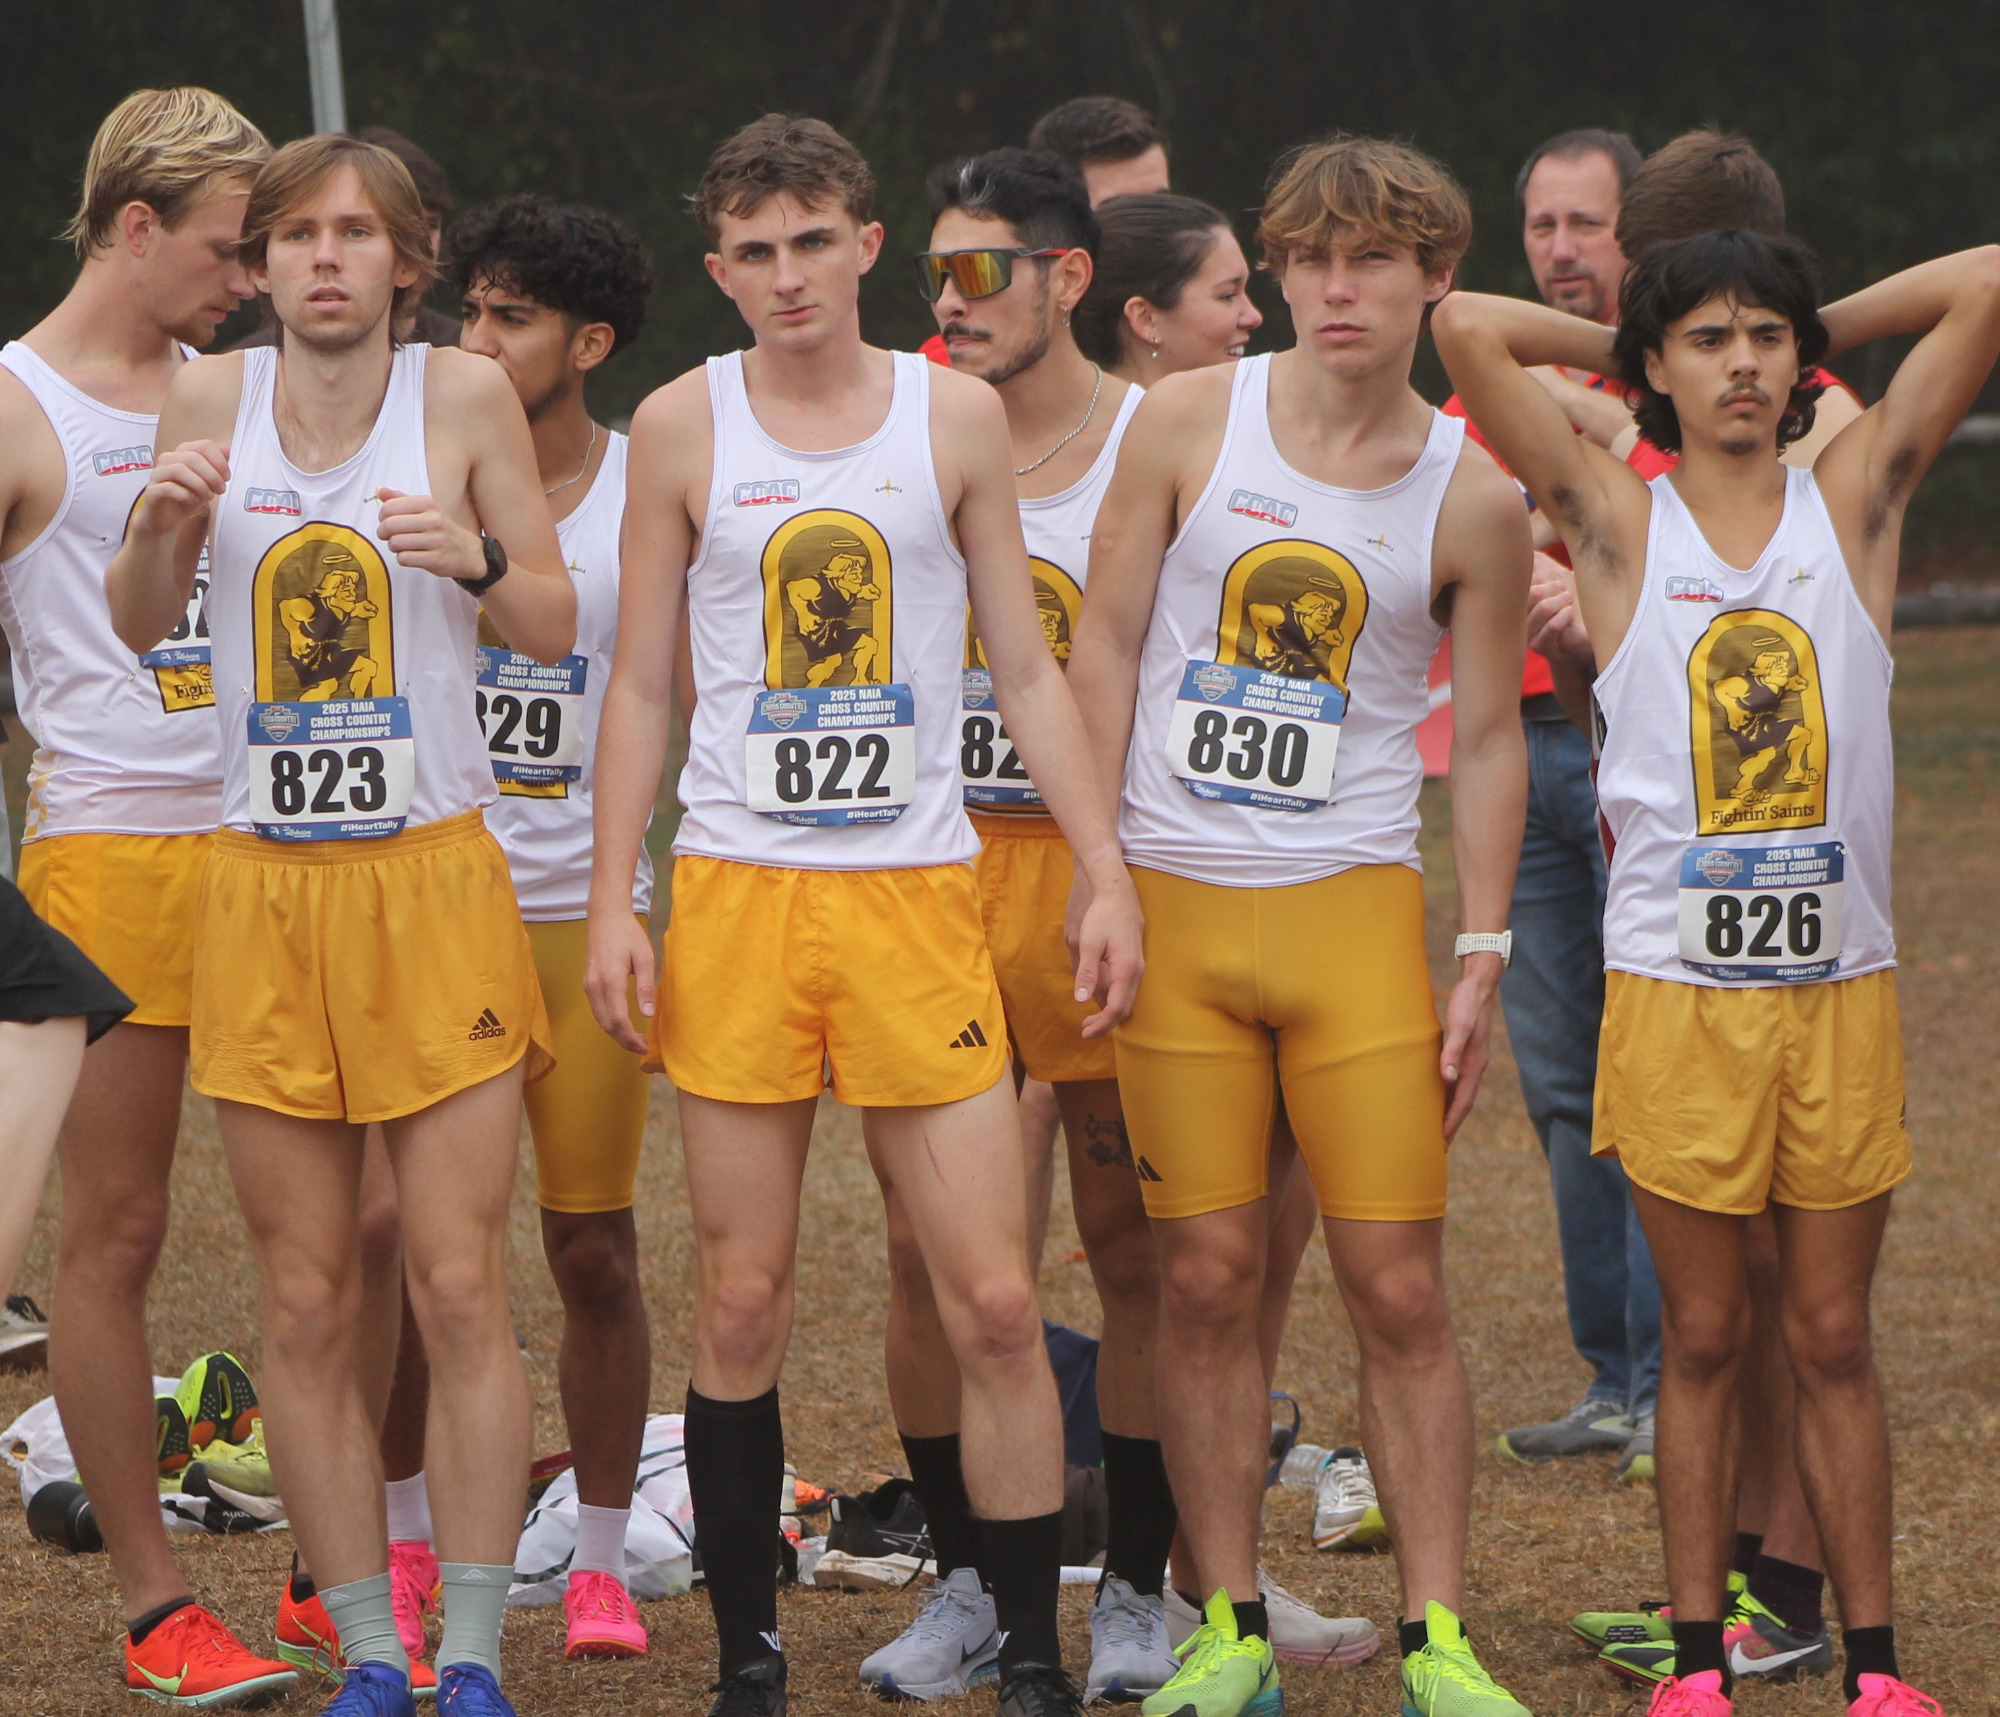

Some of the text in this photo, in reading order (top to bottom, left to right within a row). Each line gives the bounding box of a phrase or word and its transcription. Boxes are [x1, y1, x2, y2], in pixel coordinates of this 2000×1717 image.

[498, 664, 572, 680] CROSS COUNTRY
[174, 679, 214, 701] Fighti
[497, 676, 570, 692] CHAMPIONSHIPS
[1259, 673, 1311, 692] 2025 NAIA
[830, 688, 882, 702] 2025 NAIA
[1245, 684, 1277, 699] CROSS
[1280, 690, 1325, 706] COUNTRY
[322, 701, 375, 715] 2025 NAIA
[818, 700, 896, 715] CROSS COUNTRY
[1242, 696, 1321, 719] CHAMPIONSHIPS
[310, 713, 391, 729] CROSS COUNTRY
[817, 713, 896, 728] CHAMPIONSHIPS
[310, 726, 391, 741] CHAMPIONSHIPS
[961, 715, 1030, 780] 82
[1187, 709, 1309, 788] 830
[511, 766, 565, 777] #iHeartTally
[775, 733, 890, 803] 822
[271, 746, 387, 816] 823
[1250, 792, 1307, 809] #iHeartTally
[846, 808, 900, 819] #iHeartTally
[1710, 804, 1815, 827] Fightin' Saints
[340, 821, 399, 833] #iHeartTally
[1765, 847, 1816, 862] 2025 NAIA
[1753, 858, 1829, 875] CROSS COUNTRY
[1752, 871, 1828, 887] CHAMPIONSHIPS
[1705, 892, 1822, 958] 826
[1776, 964, 1827, 977] #iHeartTally
[468, 1026, 507, 1041] adidas
